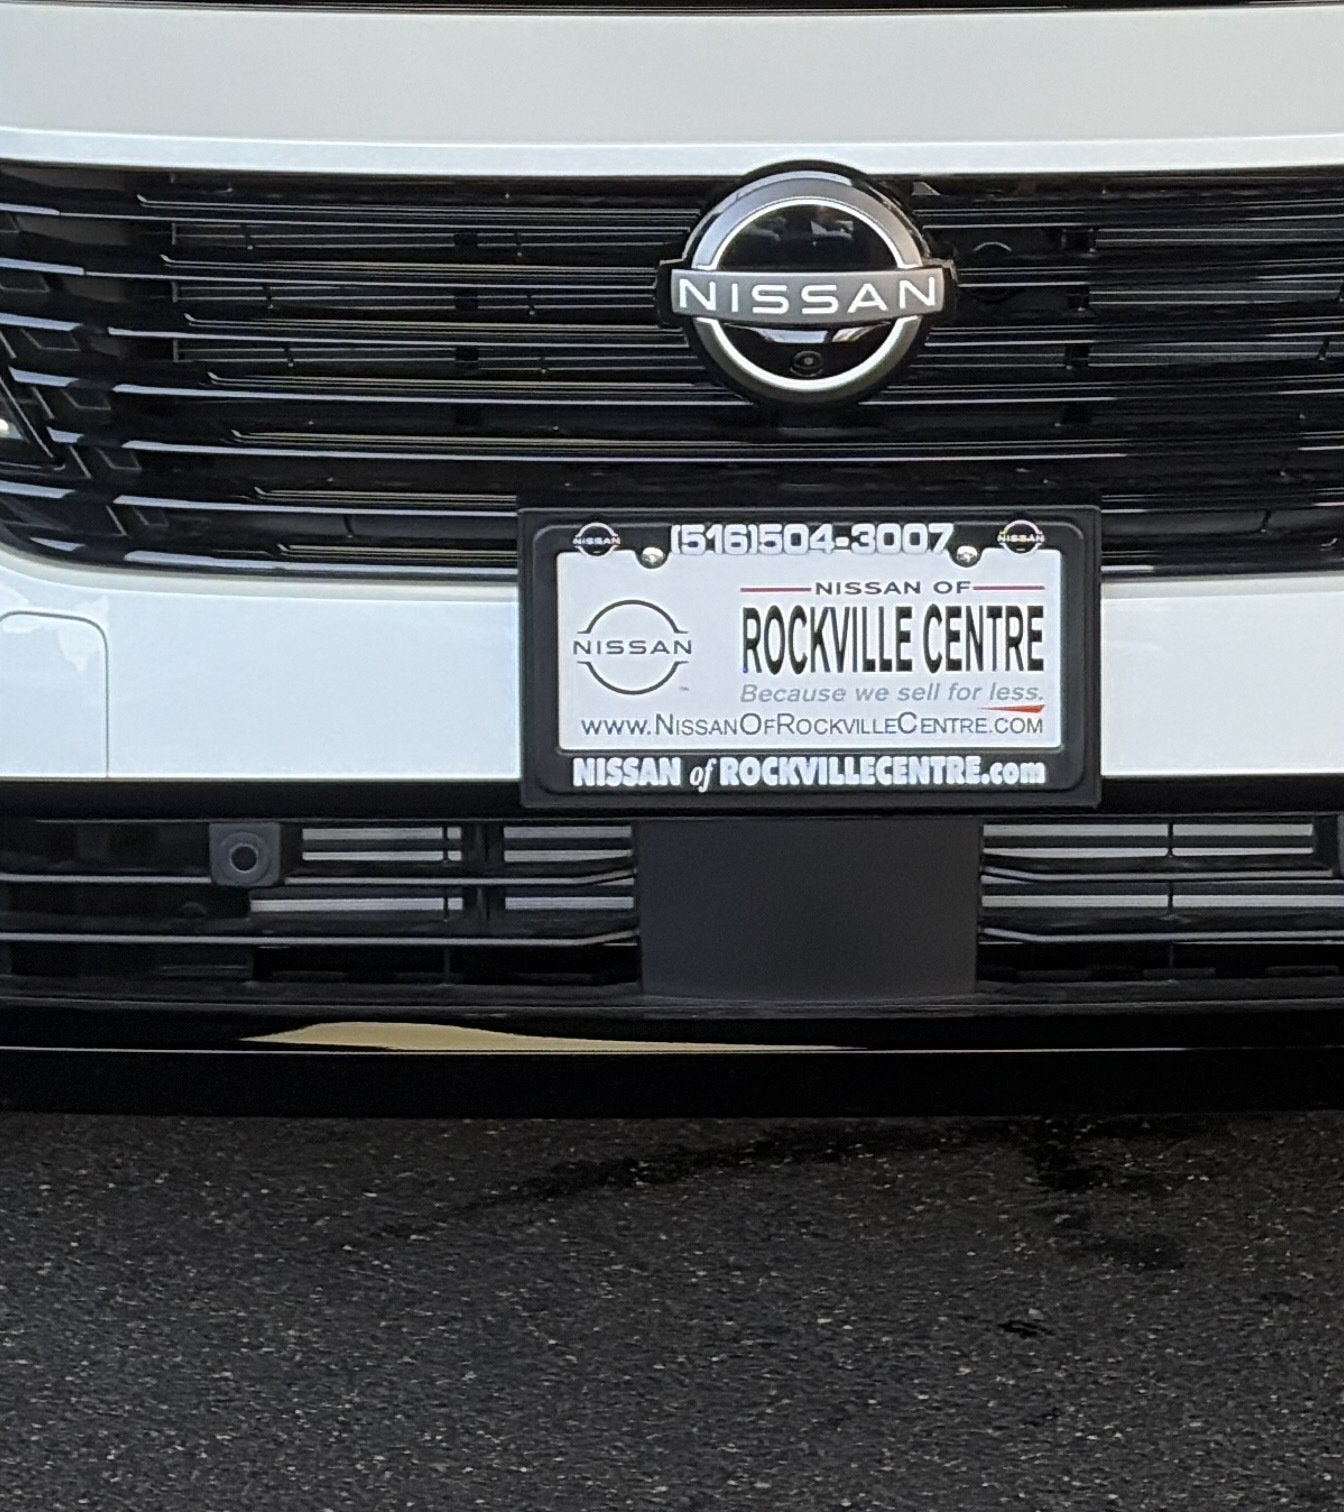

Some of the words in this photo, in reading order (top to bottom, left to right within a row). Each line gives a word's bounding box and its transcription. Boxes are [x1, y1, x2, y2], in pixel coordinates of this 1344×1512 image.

[678, 276, 937, 315] NISSAN
[573, 536, 621, 546] NISSAN
[670, 522, 955, 556] (516)504-3007
[997, 533, 1045, 543] NISSAN
[815, 581, 921, 595] NISSAN
[933, 581, 972, 594] OF
[573, 640, 692, 655] NISSAN
[742, 604, 913, 675] ROCKVILLE
[923, 604, 1044, 674] CENTRE
[740, 684, 846, 703] Because
[855, 689, 890, 702] we
[897, 683, 939, 701] sell
[947, 682, 982, 701] for
[989, 682, 1045, 701] less.
[572, 756, 682, 787] NISSAN
[689, 757, 718, 793] of
[719, 754, 1047, 786] ROCKVILLECENTRE.com
